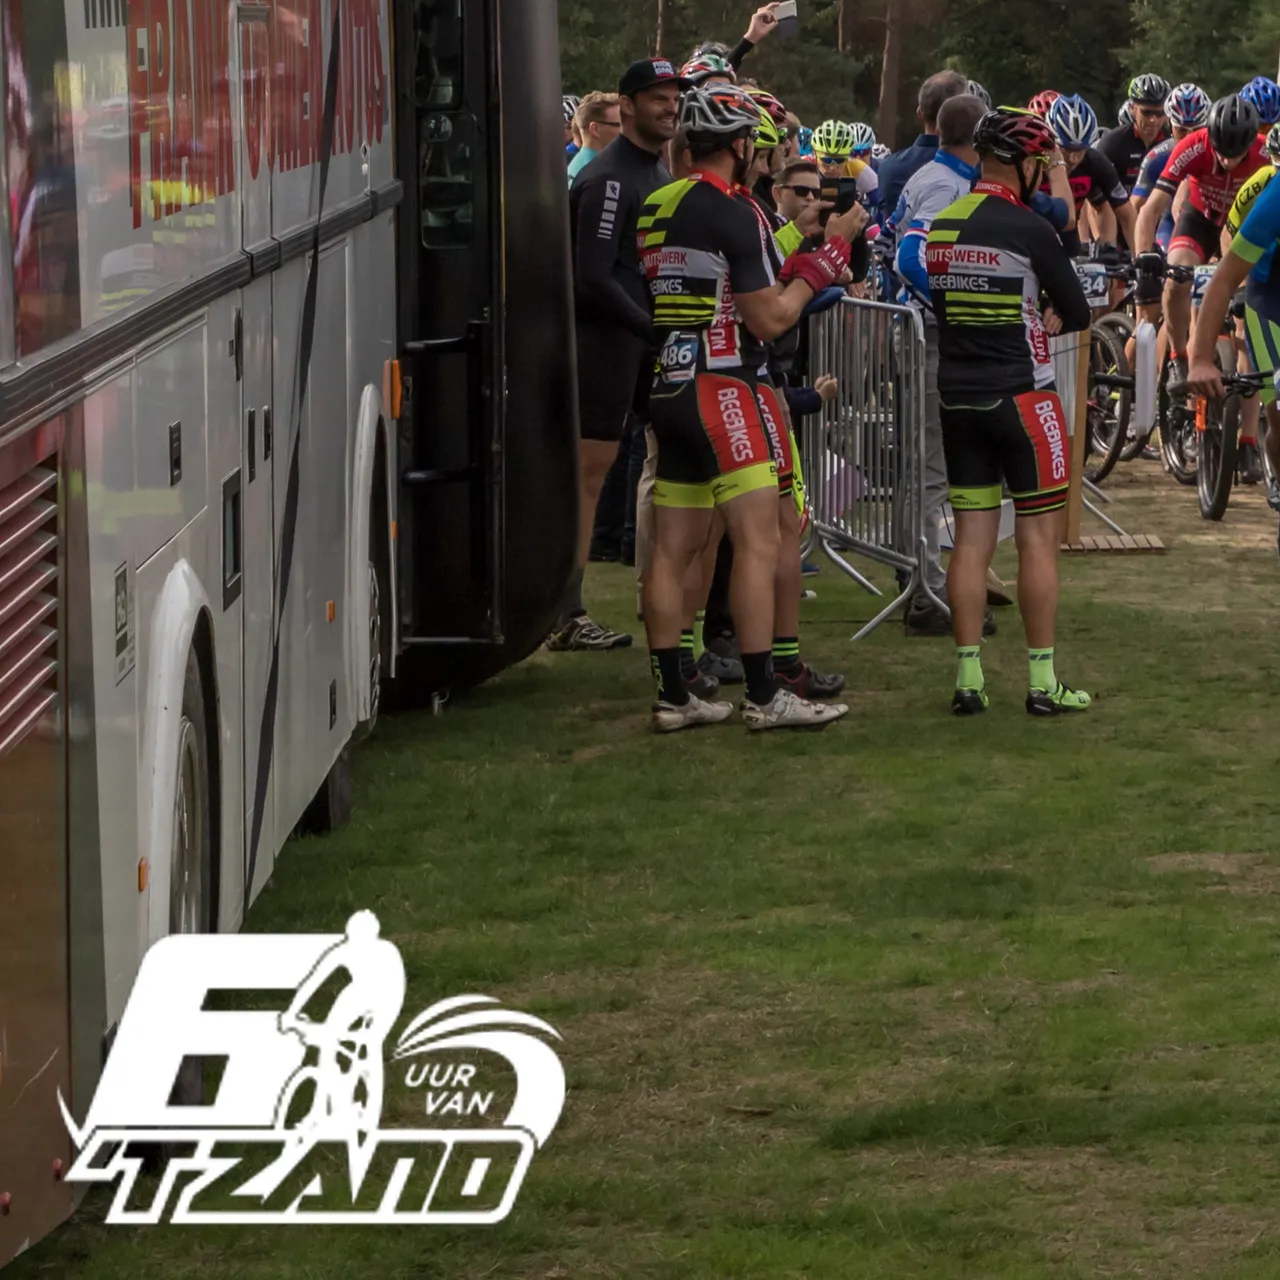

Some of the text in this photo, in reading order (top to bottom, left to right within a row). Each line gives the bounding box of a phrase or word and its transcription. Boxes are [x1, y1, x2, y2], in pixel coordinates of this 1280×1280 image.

[927, 250, 1001, 266] NUTSWERK
[661, 344, 693, 367] 486
[1034, 399, 1066, 481] BEEBIKES
